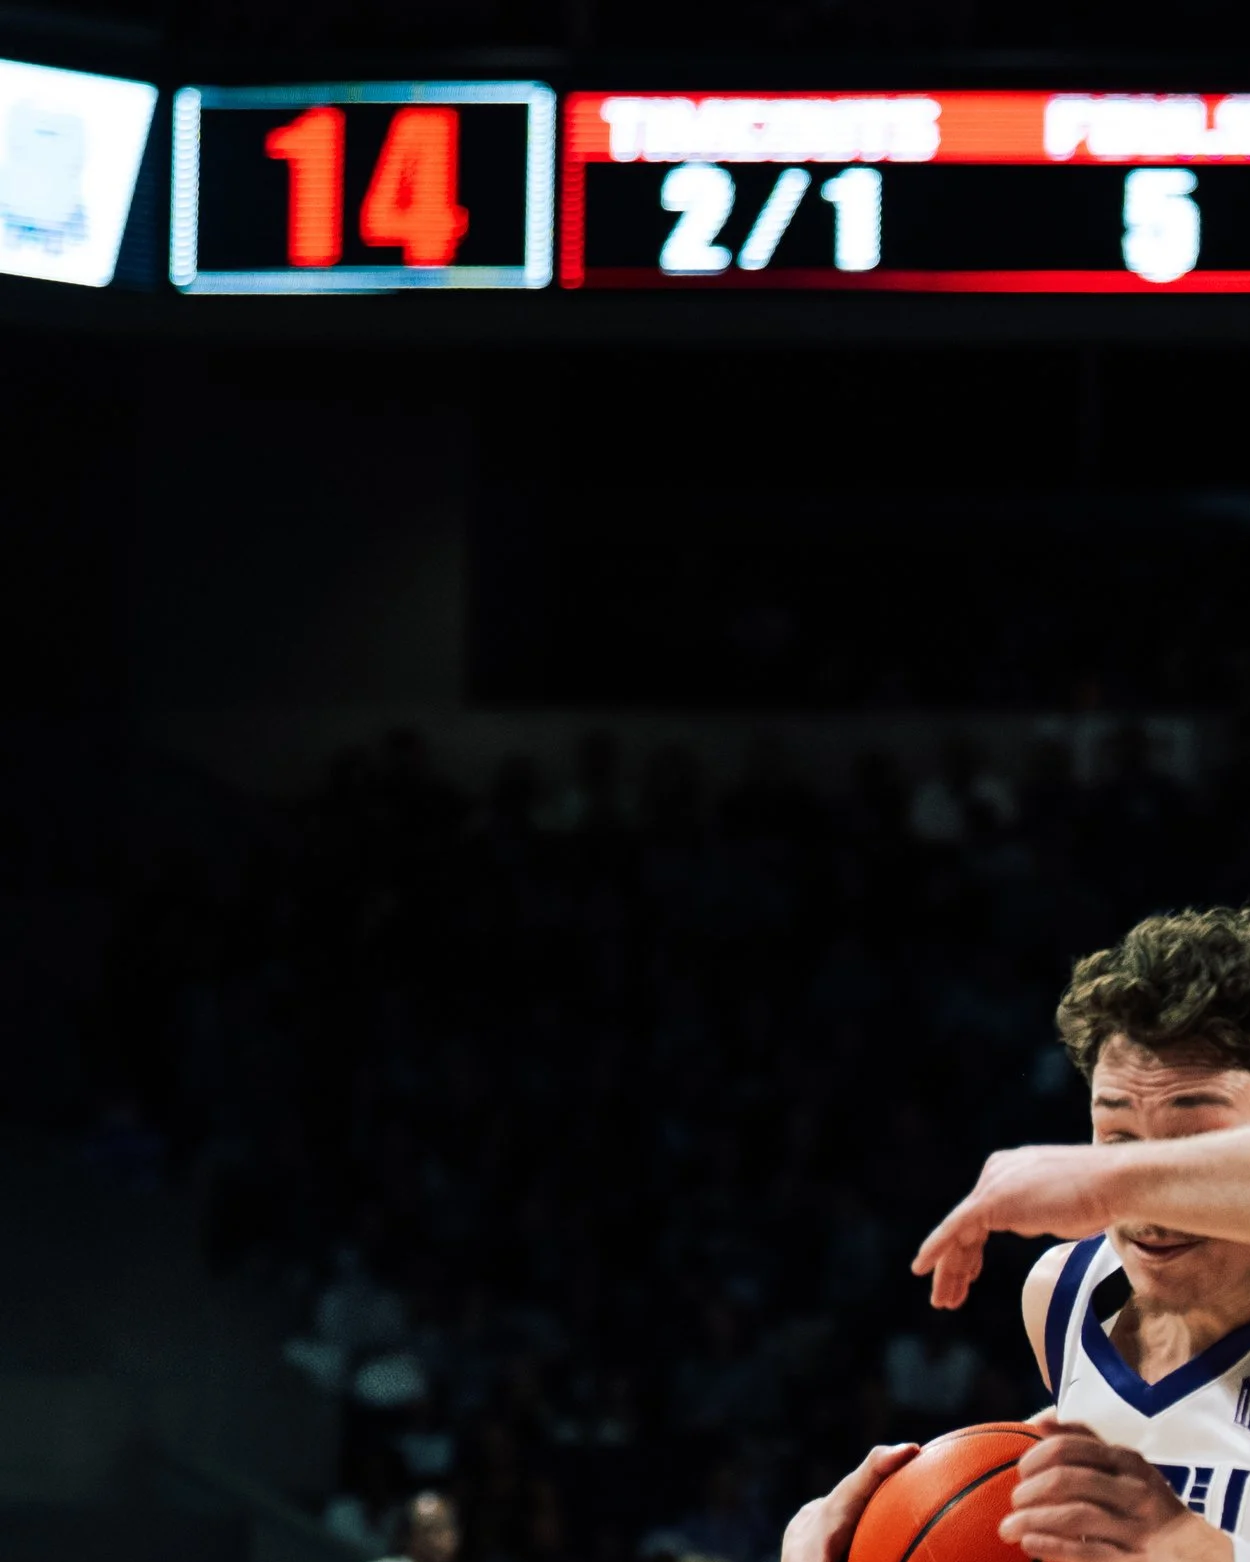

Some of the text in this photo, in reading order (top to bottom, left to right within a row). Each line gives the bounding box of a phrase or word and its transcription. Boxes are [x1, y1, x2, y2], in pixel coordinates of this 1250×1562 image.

[265, 106, 468, 267] 14
[660, 165, 882, 275] 2/1
[1121, 167, 1200, 283] 5
